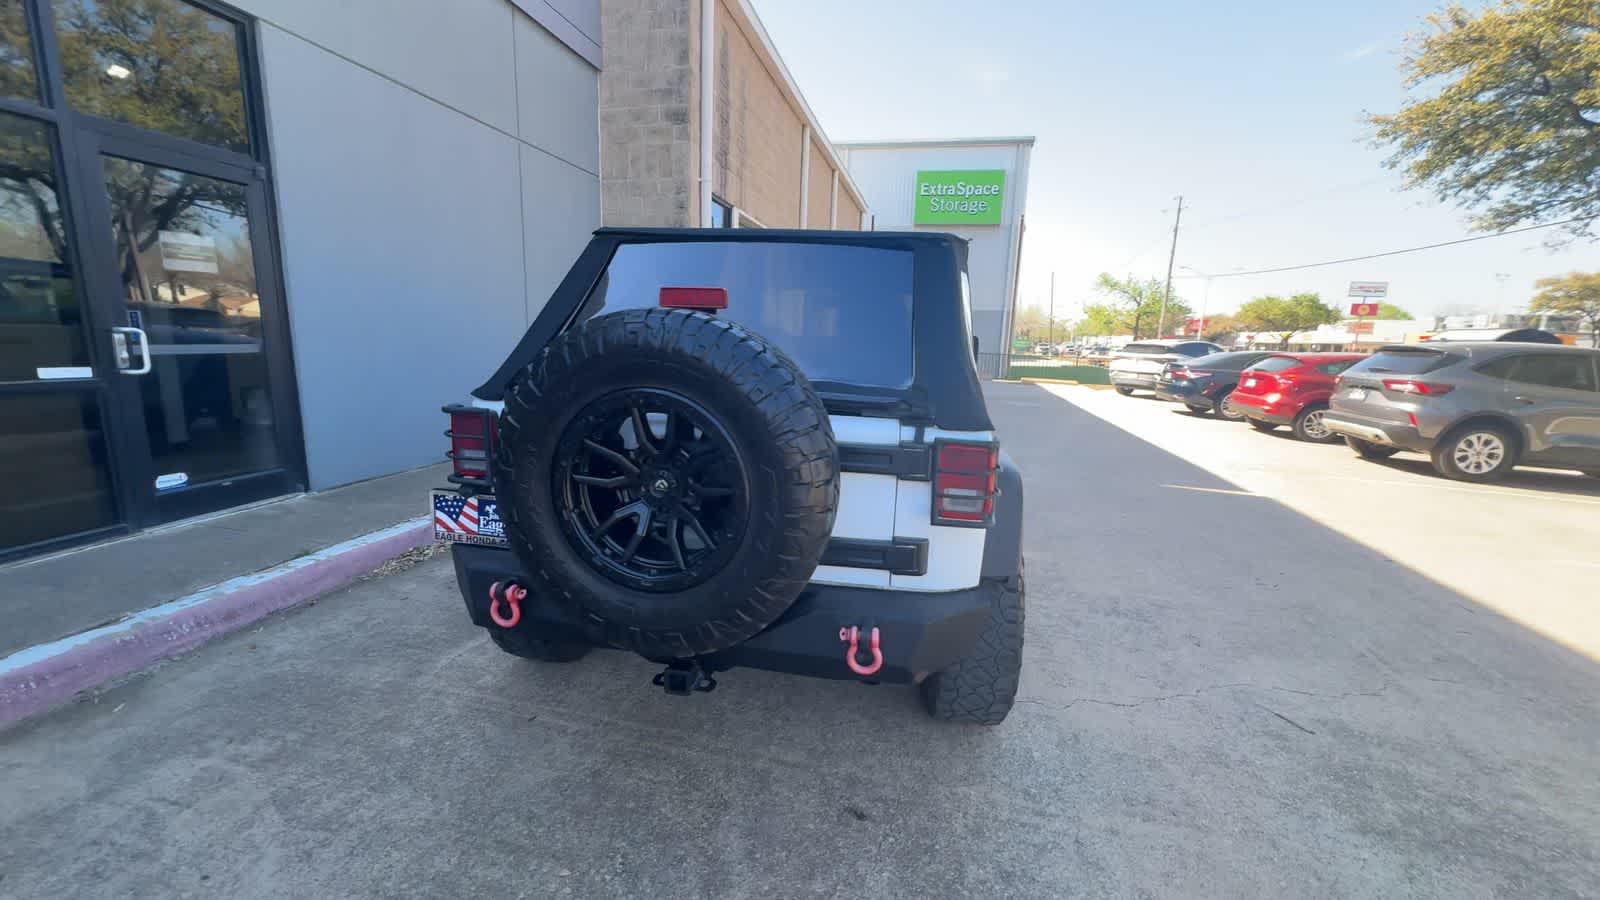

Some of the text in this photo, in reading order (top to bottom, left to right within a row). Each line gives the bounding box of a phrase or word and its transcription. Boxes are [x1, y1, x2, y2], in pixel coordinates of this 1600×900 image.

[930, 197, 988, 214] Storage
[435, 531, 497, 545] EAGLE HONDA
